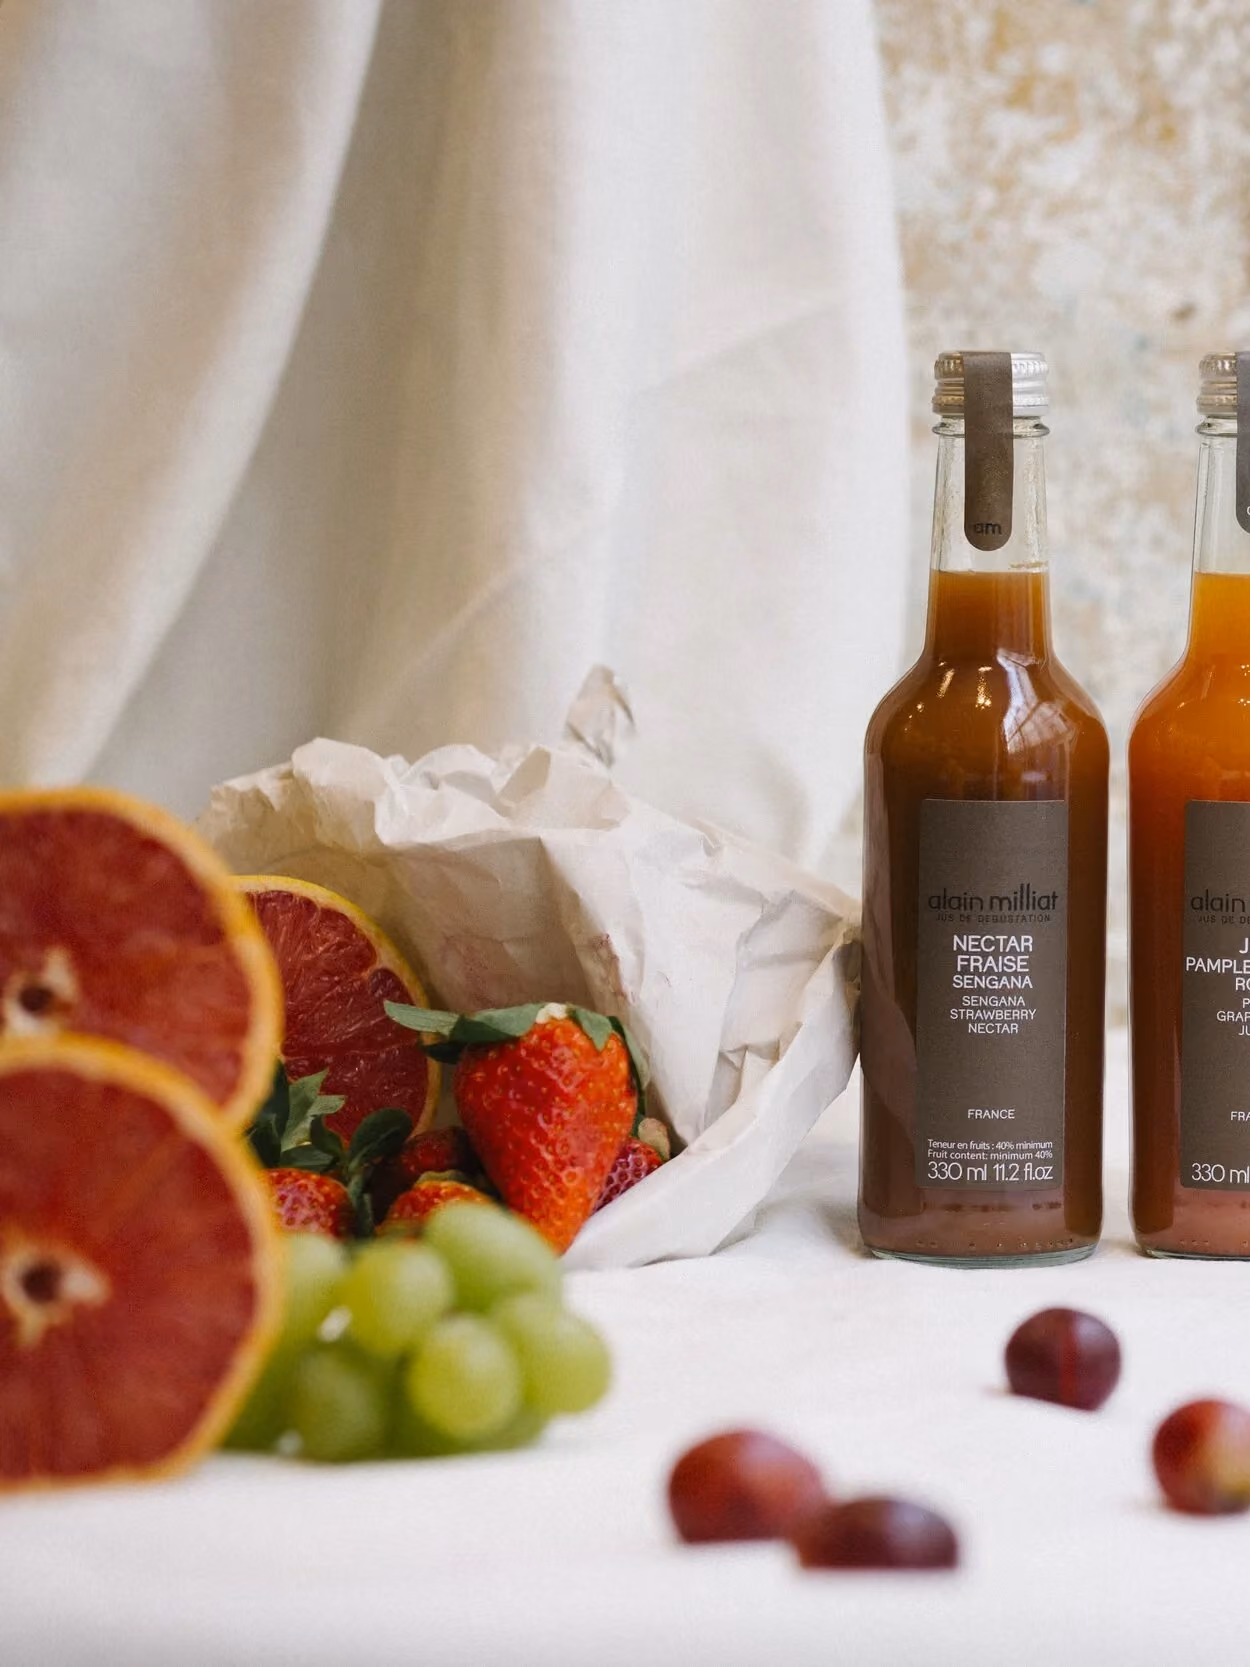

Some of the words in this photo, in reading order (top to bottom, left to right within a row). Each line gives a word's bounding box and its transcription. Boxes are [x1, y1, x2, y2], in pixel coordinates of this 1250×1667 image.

[973, 522, 1002, 536] am
[928, 888, 984, 911] alain
[990, 883, 1058, 911] milliat
[1191, 889, 1245, 912] alain
[937, 913, 954, 922] JUS
[959, 914, 972, 923] DE
[1198, 914, 1216, 923] JUS
[1221, 915, 1236, 924] DE
[953, 934, 1033, 952] NECTAR
[957, 955, 1030, 973] FRAISE
[952, 974, 1033, 989] SENGANA
[962, 995, 1026, 1007] SENGANA
[950, 1008, 1036, 1020] STRAWBERRY
[968, 1023, 1019, 1034] NECTAR
[967, 1108, 1016, 1119] FRANCE
[927, 1138, 955, 1149] Teneur
[996, 1141, 1014, 1150] 40%
[1015, 1140, 1053, 1149] minimum
[927, 1149, 947, 1159] Fruit
[949, 1151, 988, 1160] content:
[990, 1151, 1033, 1160] minimum
[1035, 1150, 1053, 1159] 40%
[927, 1161, 963, 1180] 330
[966, 1163, 988, 1181] ml
[992, 1162, 1020, 1181] 11.2
[1023, 1162, 1053, 1181] fl.oz
[1191, 1162, 1225, 1183] 330
[1229, 1166, 1250, 1184] ml
